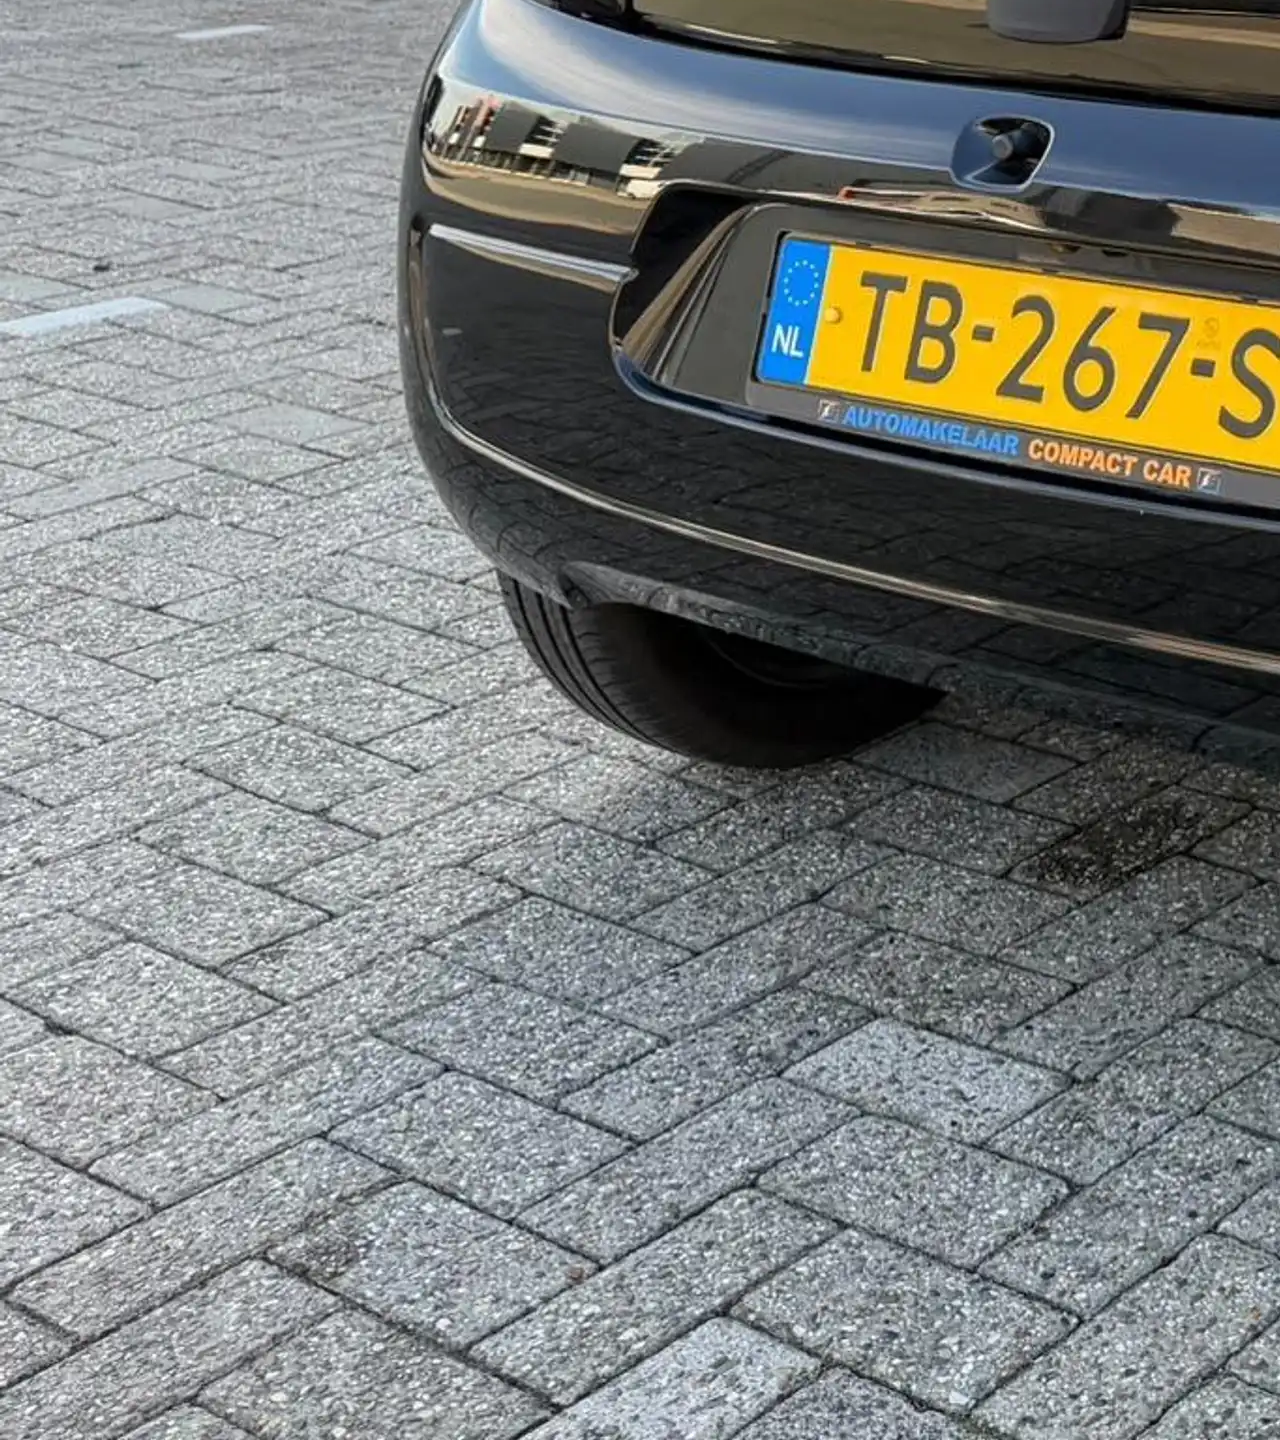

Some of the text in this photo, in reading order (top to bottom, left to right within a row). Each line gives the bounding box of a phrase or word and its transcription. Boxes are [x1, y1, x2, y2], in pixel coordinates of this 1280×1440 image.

[771, 323, 804, 358] NL
[844, 404, 1193, 489] AUTOMAKELAAR COMPACT CAR
